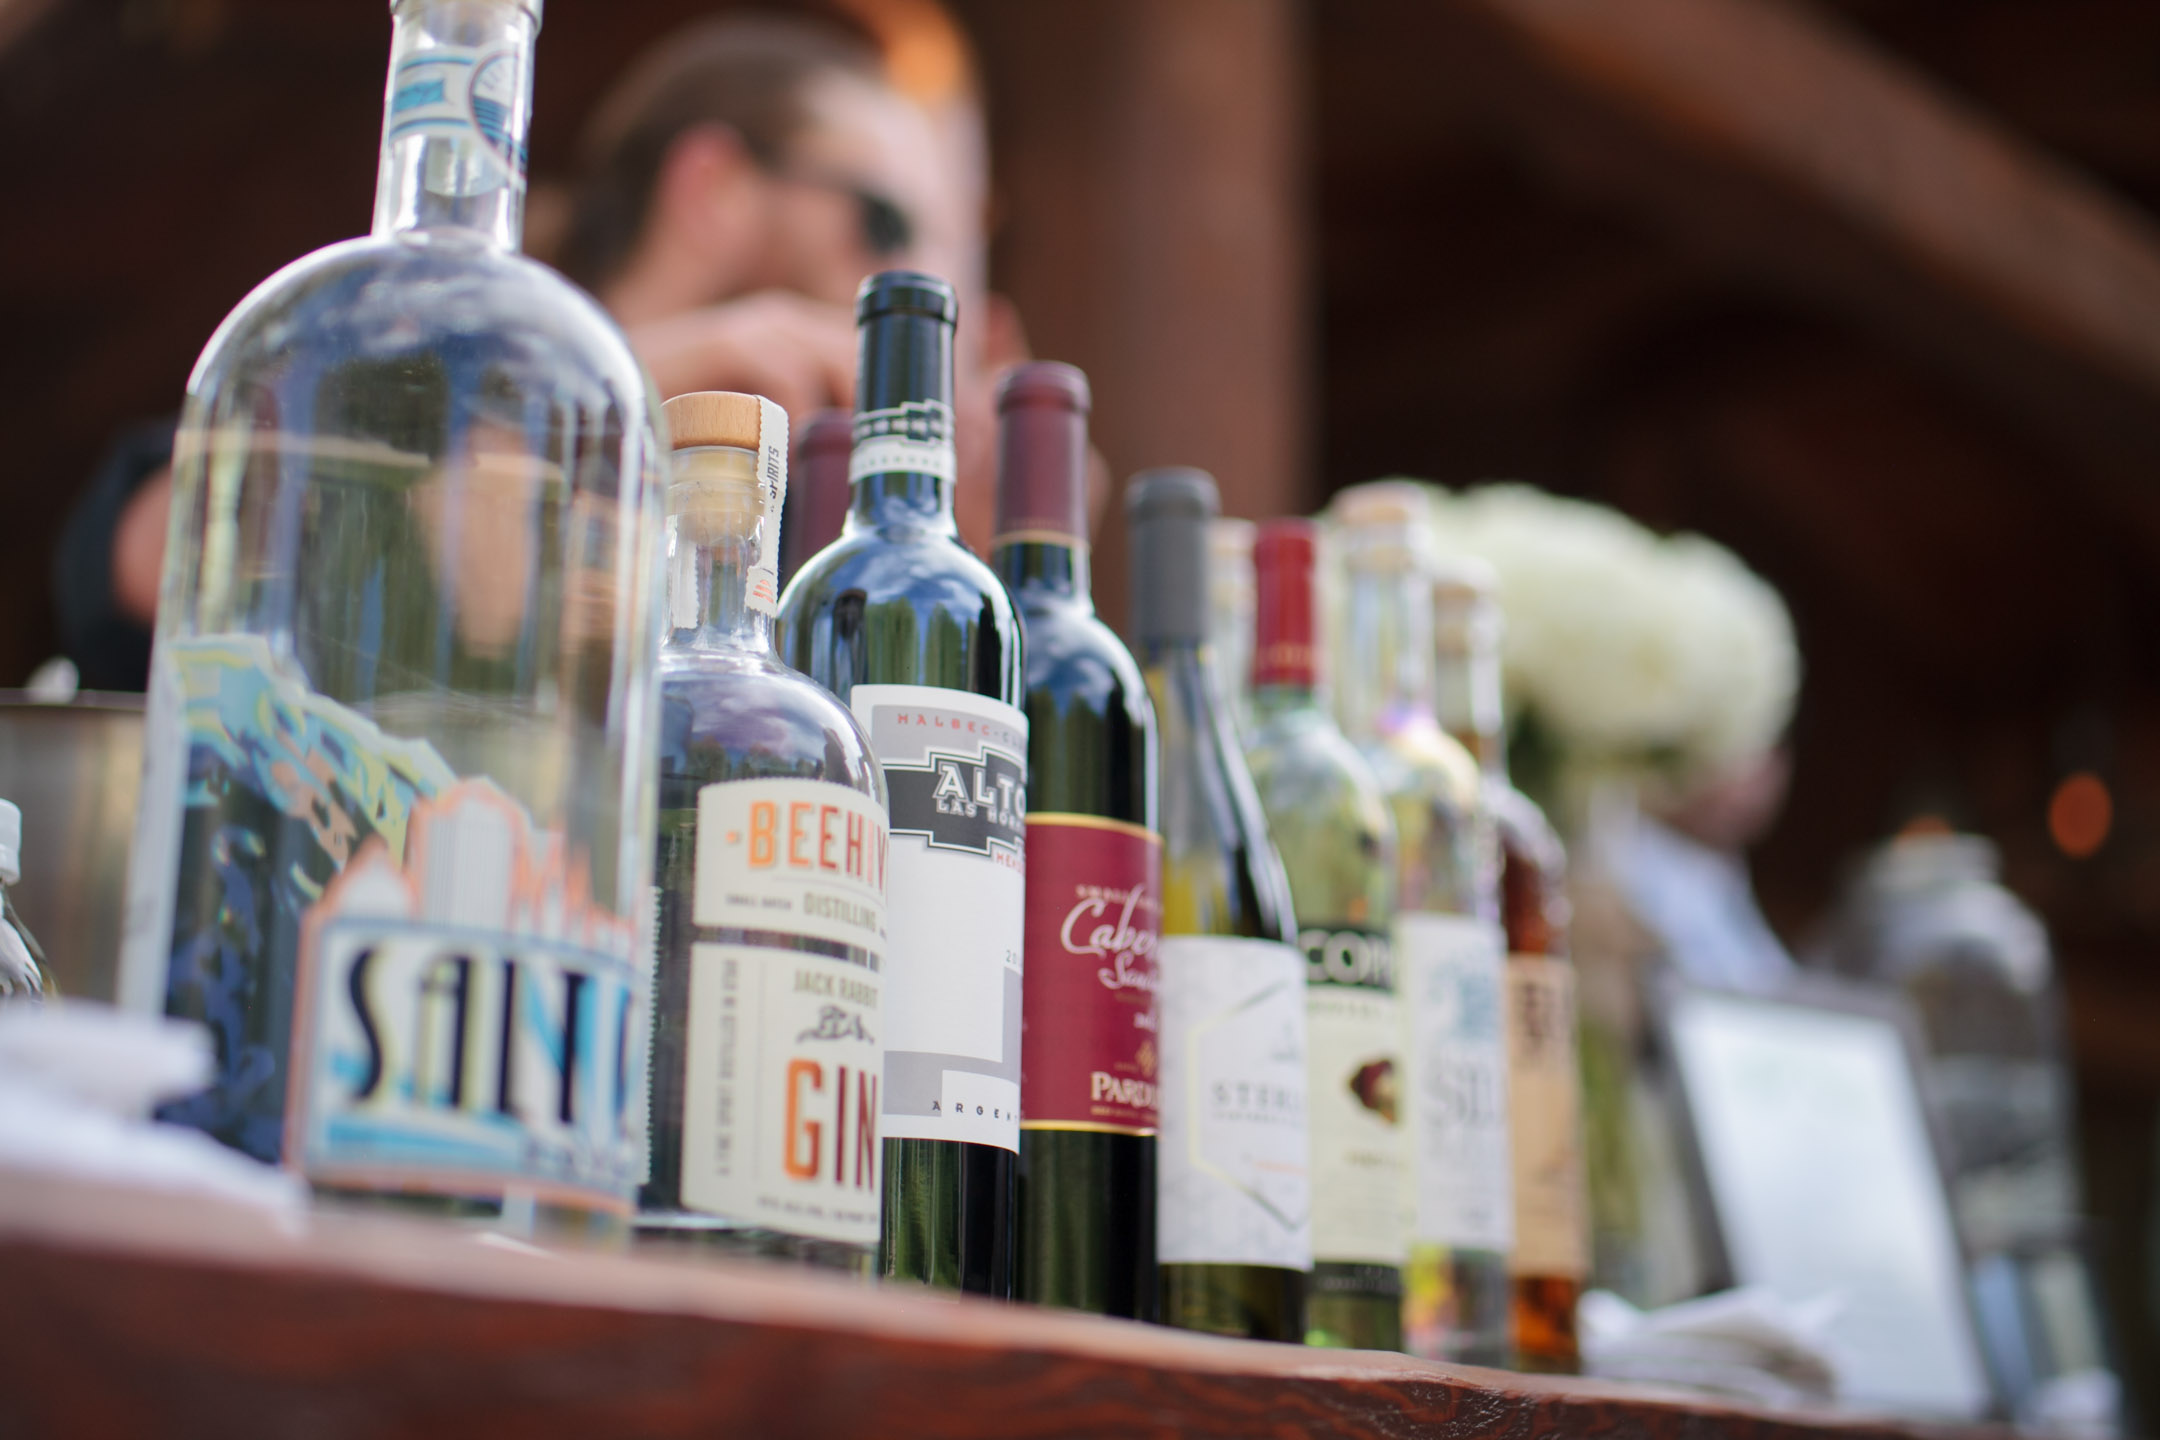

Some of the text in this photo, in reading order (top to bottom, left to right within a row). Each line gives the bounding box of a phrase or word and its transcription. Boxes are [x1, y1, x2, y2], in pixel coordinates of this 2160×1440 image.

[748, 800, 889, 896] BEEHIV
[937, 797, 977, 818] LAS
[783, 1057, 878, 1192] GIN
